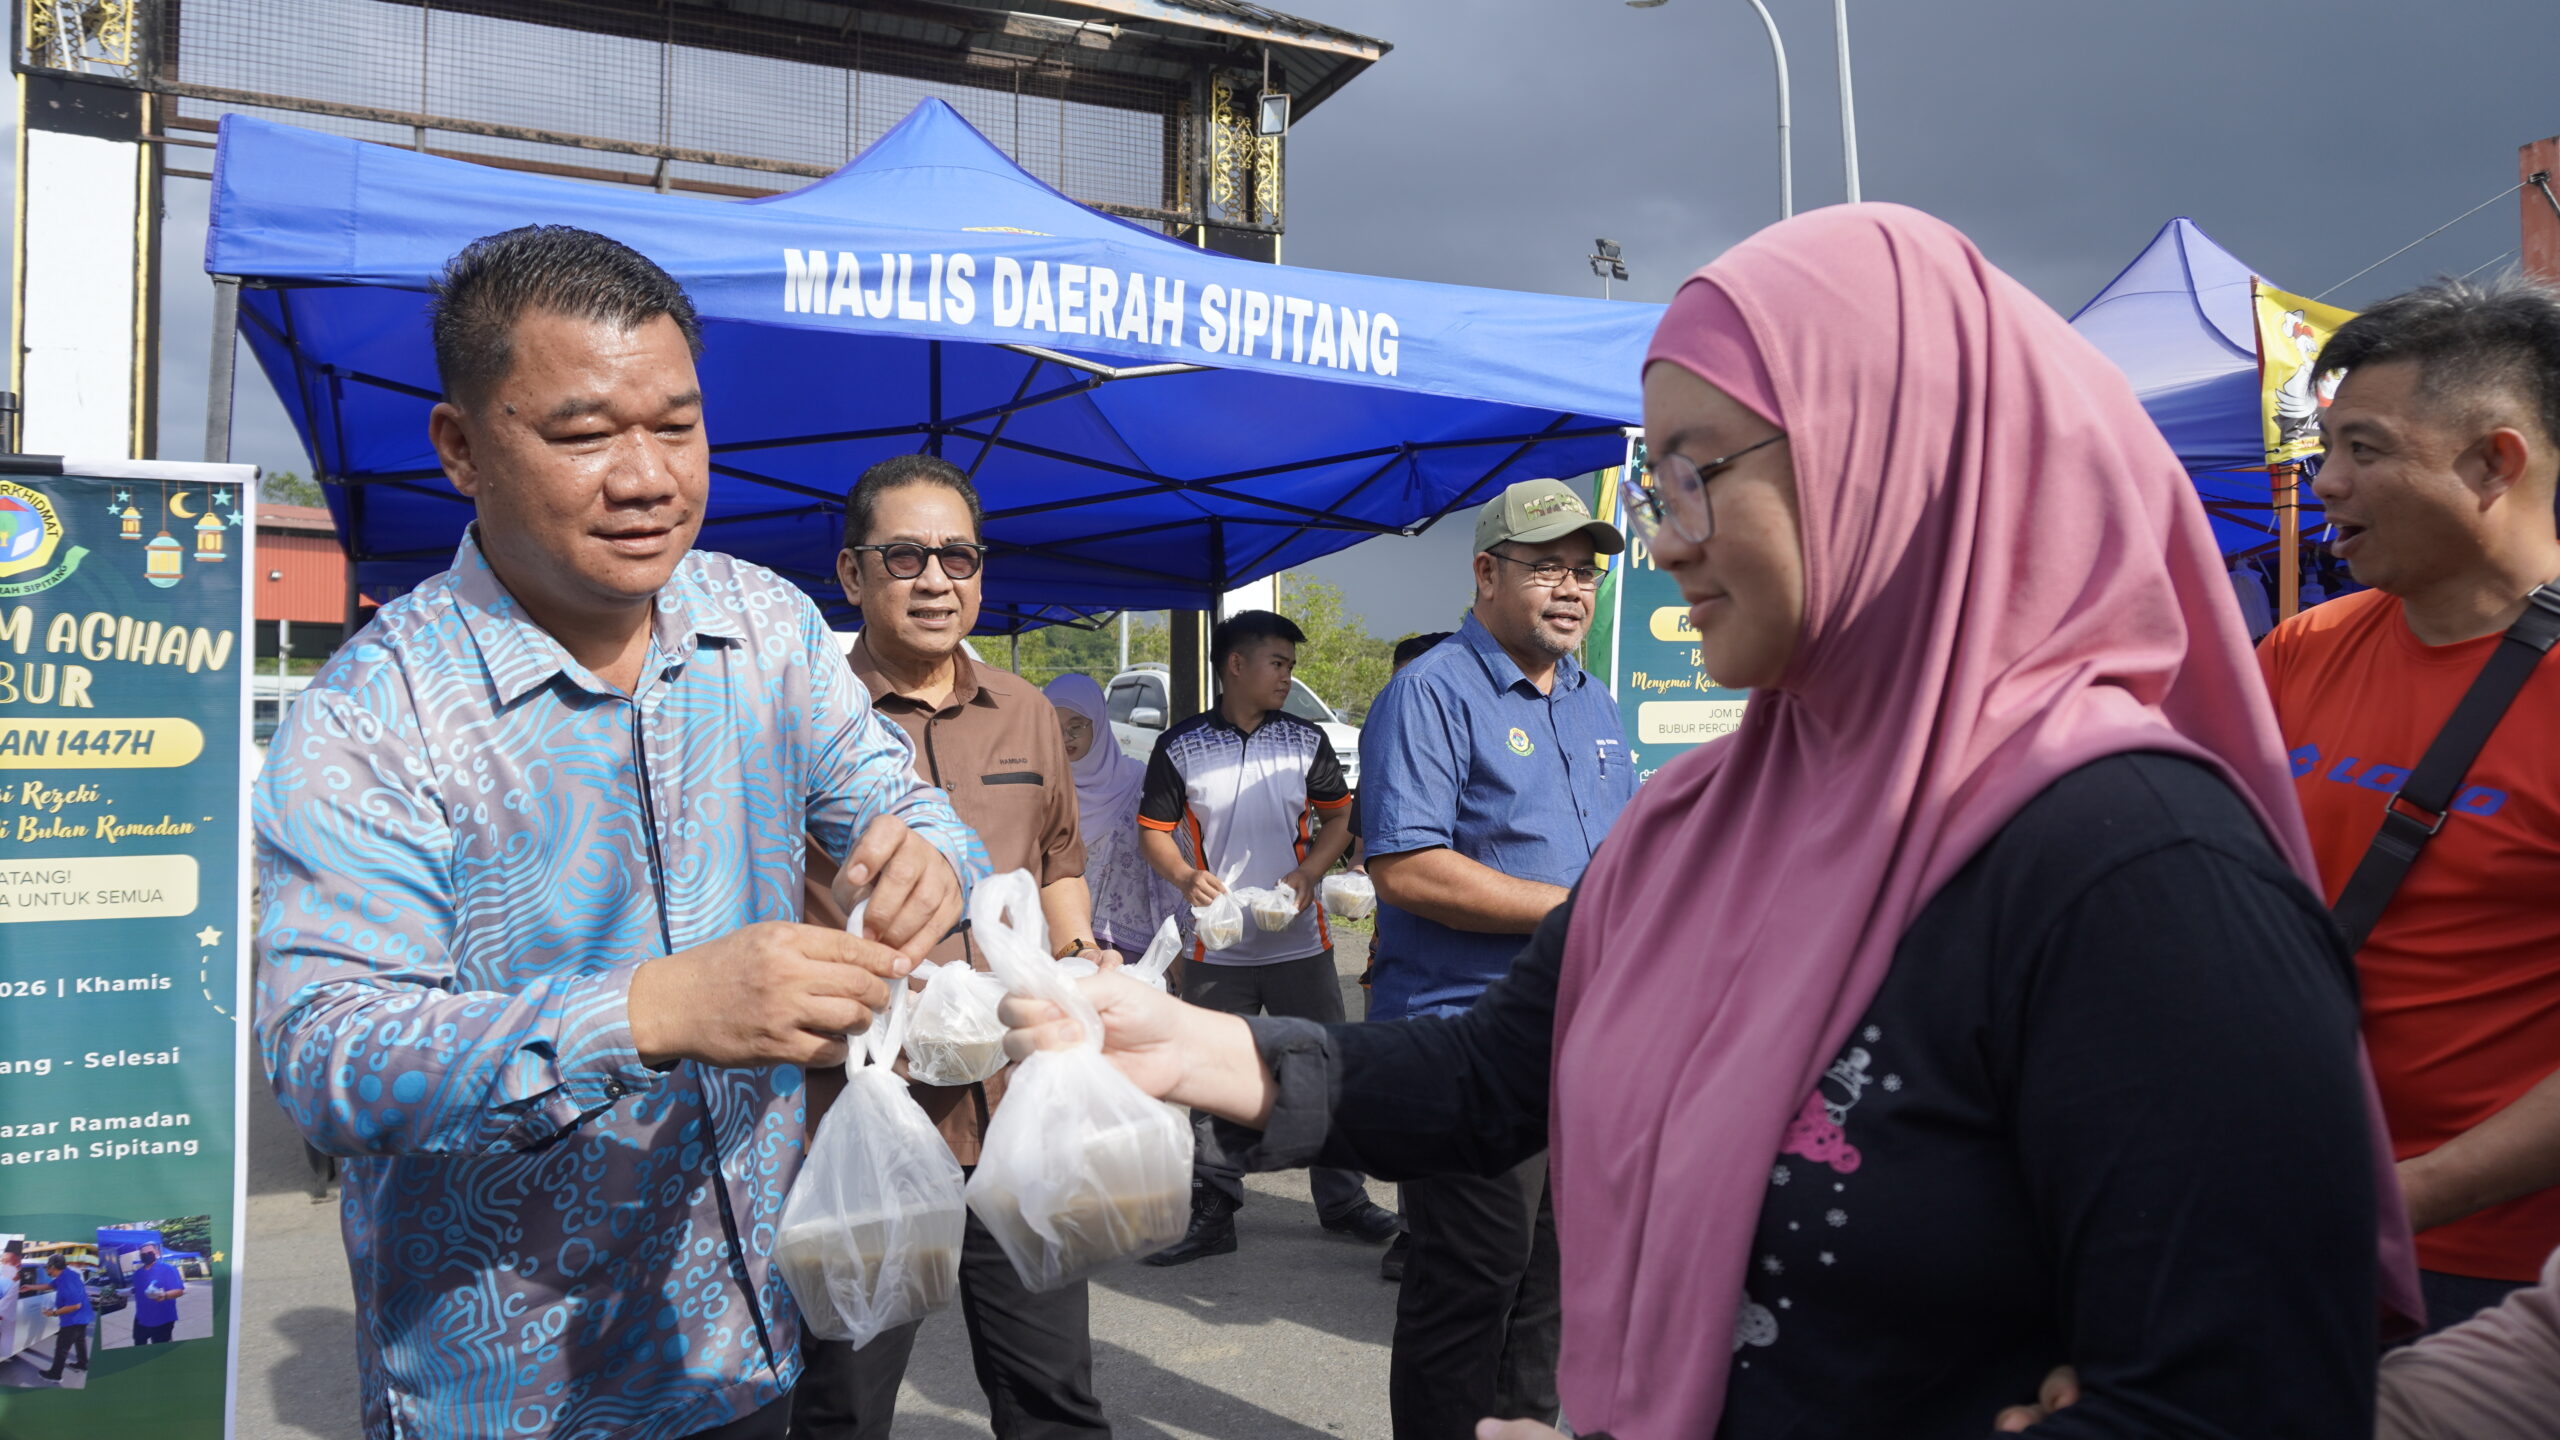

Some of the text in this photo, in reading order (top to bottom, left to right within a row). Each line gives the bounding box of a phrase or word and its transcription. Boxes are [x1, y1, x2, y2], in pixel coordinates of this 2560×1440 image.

[783, 248, 1399, 377] MAJLIS DAERAH SIPITANG
[0, 484, 59, 537] RKHIDMAT
[23, 565, 68, 593] SIPITANG
[45, 611, 234, 674] AGIHAN
[0, 661, 95, 708] BUR
[1631, 671, 1692, 694] Menyemai
[1709, 709, 1732, 719] JOM
[56, 729, 155, 756] 1447H
[1658, 724, 1696, 734] BUBUR
[20, 780, 100, 814] Rezeki
[16, 815, 90, 843] Bulan
[95, 815, 195, 844] Ramadan
[0, 870, 72, 885] ATANG!
[18, 891, 91, 907] UNTUK
[96, 889, 164, 904] SEMUA
[0, 980, 47, 998] 026
[76, 973, 172, 993] Khamis
[0, 1059, 52, 1075] ang
[84, 1046, 180, 1068] Selesai
[0, 1111, 191, 1138] azar Ramadan
[0, 1138, 199, 1166] aerah Sipitang
